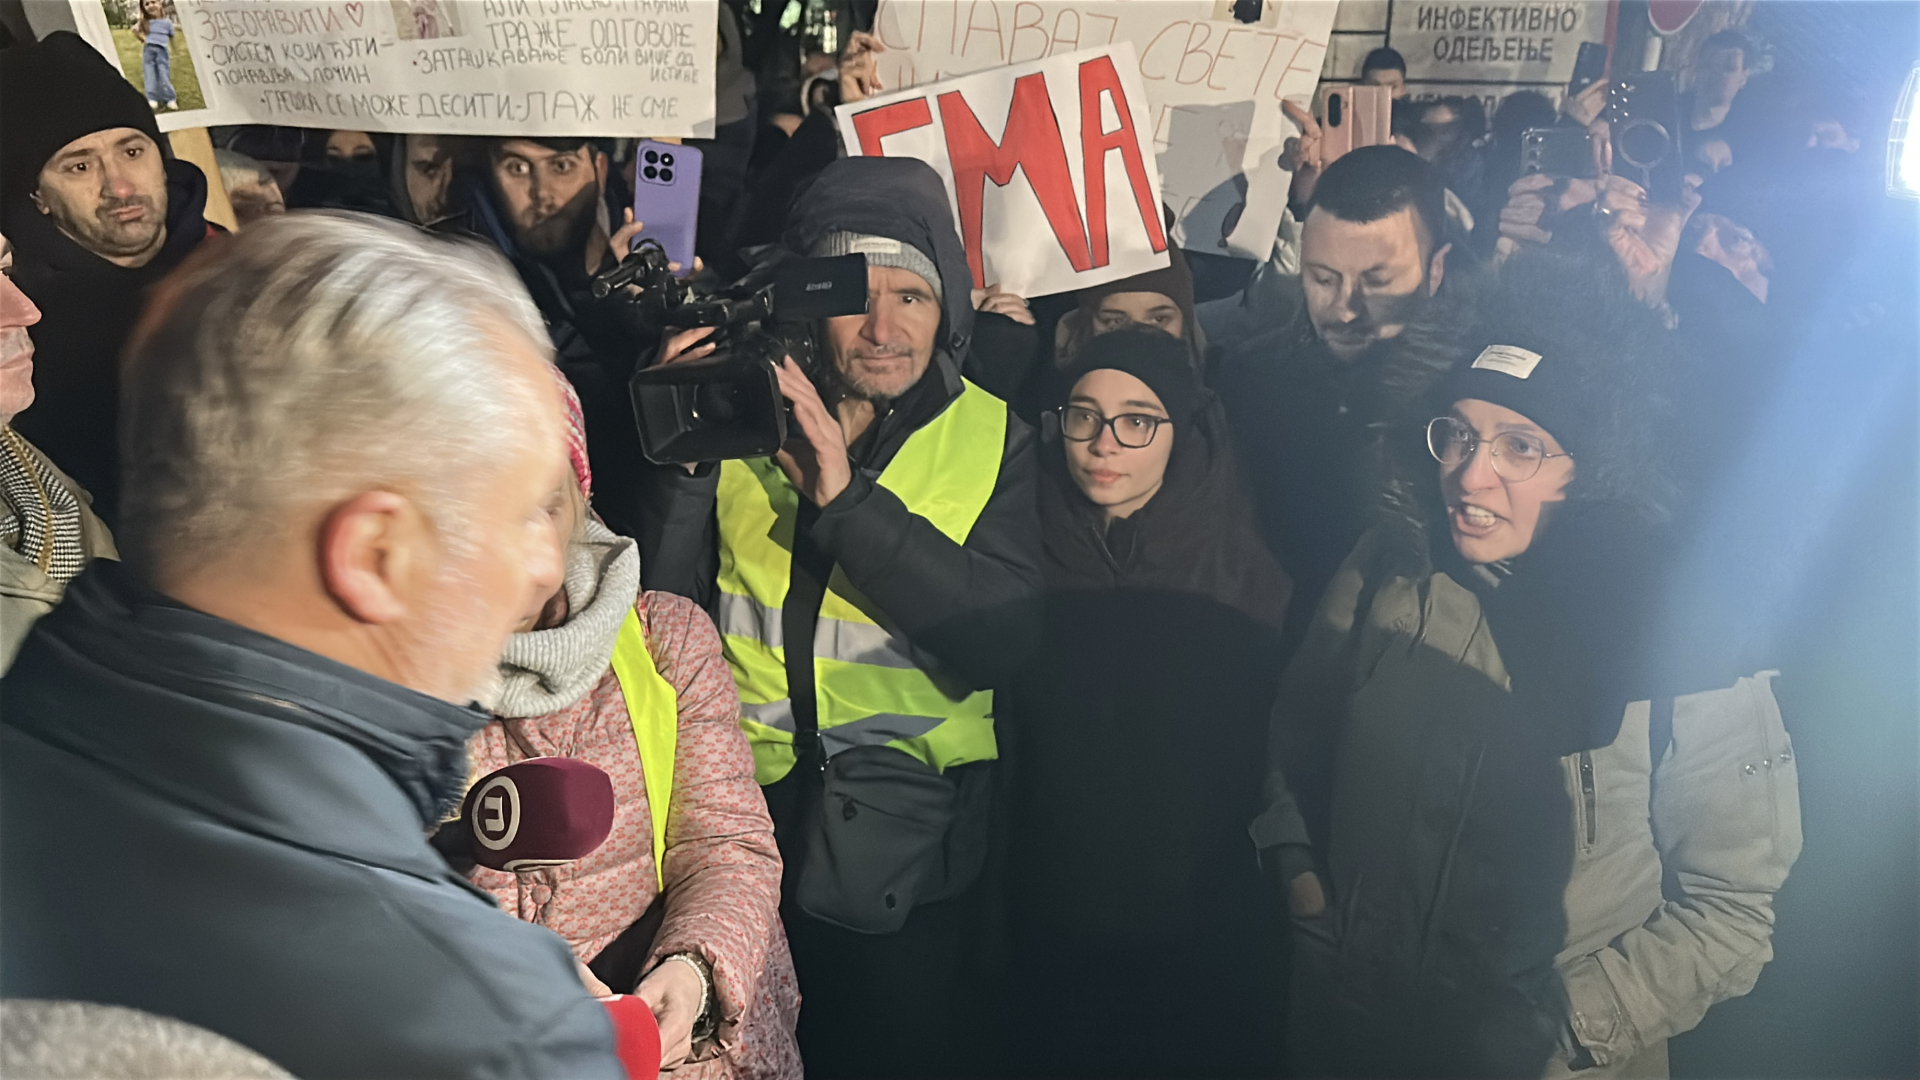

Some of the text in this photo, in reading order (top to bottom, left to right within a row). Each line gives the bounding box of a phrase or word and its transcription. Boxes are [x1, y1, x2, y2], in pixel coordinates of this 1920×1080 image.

[194, 7, 344, 41] ЗАБОРАВИТИ
[1418, 6, 1577, 32] ИНФЕКТИВНО
[485, 18, 698, 50] ТРАЖЕ ОДГОВОРЕ
[281, 43, 326, 62] КОЈИ
[326, 37, 379, 61] ЋУТИ
[417, 47, 568, 74] ЗАТАШКАВАЊЕ
[581, 47, 629, 66] БОЛИ
[1139, 20, 1327, 101] СВЕТЕ
[1433, 36, 1554, 64] ОДЕЉЕЊЕ
[213, 66, 295, 86] ПОНАВЉА
[350, 92, 409, 118] МОЖЕ
[612, 94, 634, 120] НЕ
[640, 96, 679, 120] СМЕ
